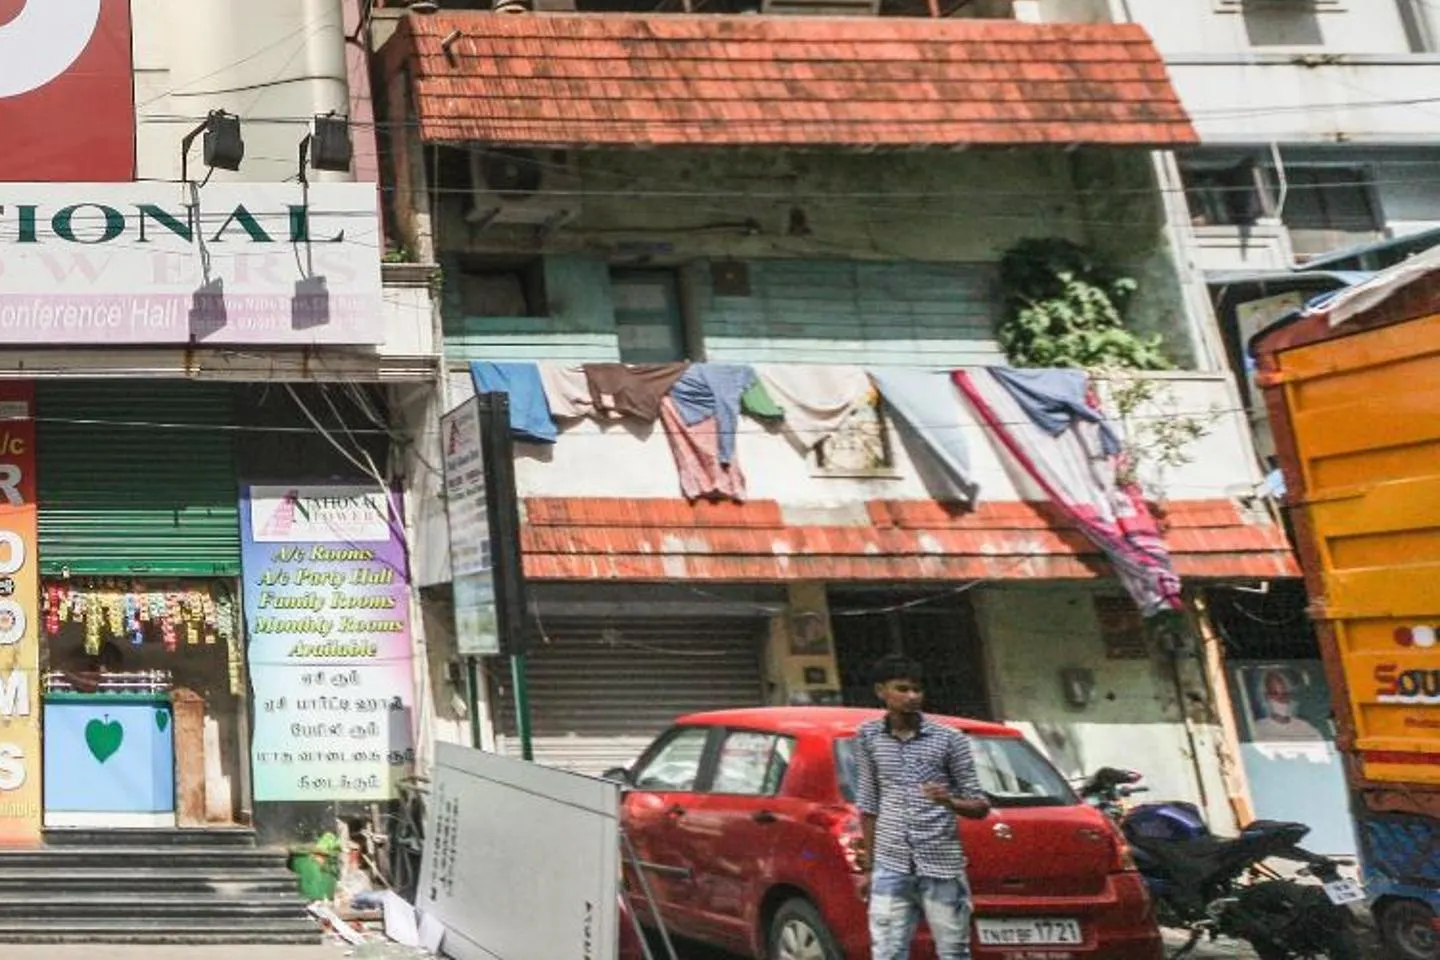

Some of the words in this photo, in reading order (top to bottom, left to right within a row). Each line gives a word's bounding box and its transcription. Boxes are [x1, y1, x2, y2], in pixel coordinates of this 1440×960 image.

[132, 298, 178, 327] Hall
[311, 544, 376, 561] Rooms
[293, 568, 346, 590] Party
[349, 568, 394, 586] Hall
[257, 592, 326, 613] Family
[330, 591, 397, 609] Rooms
[254, 615, 334, 638] Monthly
[337, 615, 405, 633] Rooms
